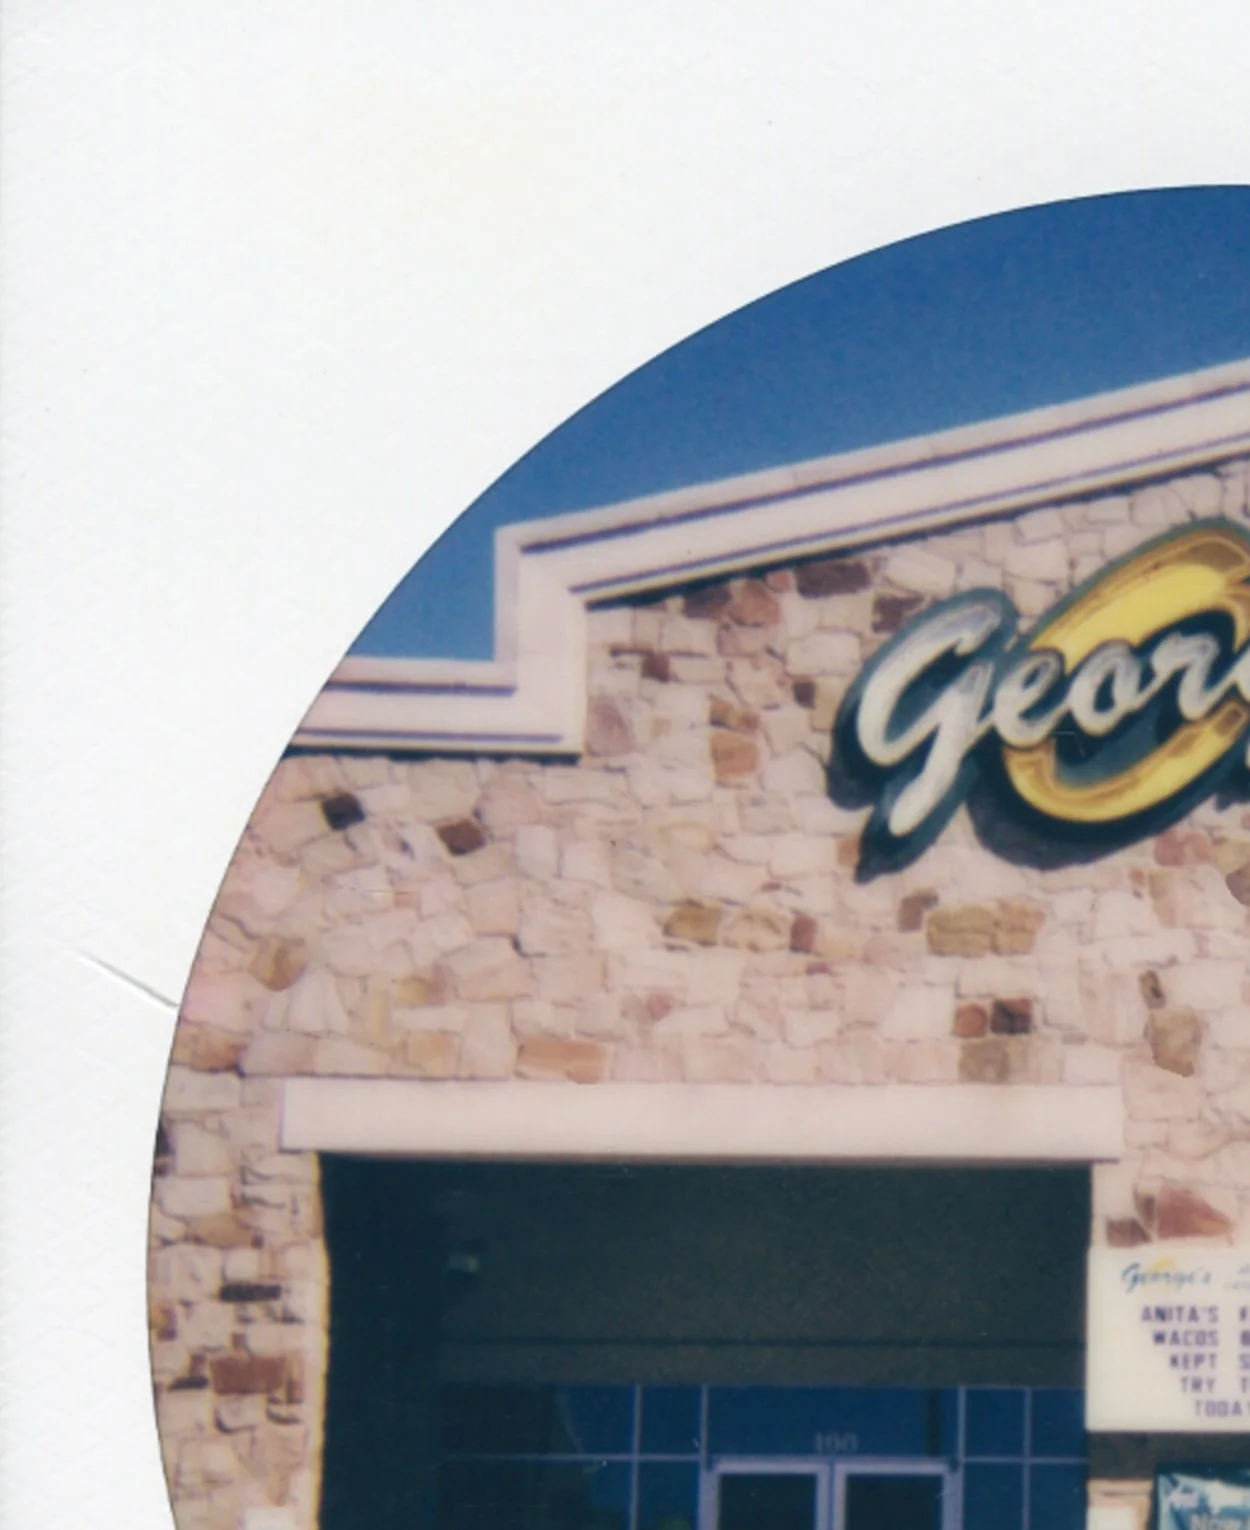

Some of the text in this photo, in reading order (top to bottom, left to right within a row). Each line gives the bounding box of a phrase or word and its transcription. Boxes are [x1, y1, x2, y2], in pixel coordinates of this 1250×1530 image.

[1140, 1305, 1220, 1324] ANITA'S
[1152, 1329, 1220, 1347] WACOS
[1169, 1353, 1219, 1371] KEPT
[1180, 1377, 1217, 1394] TRY
